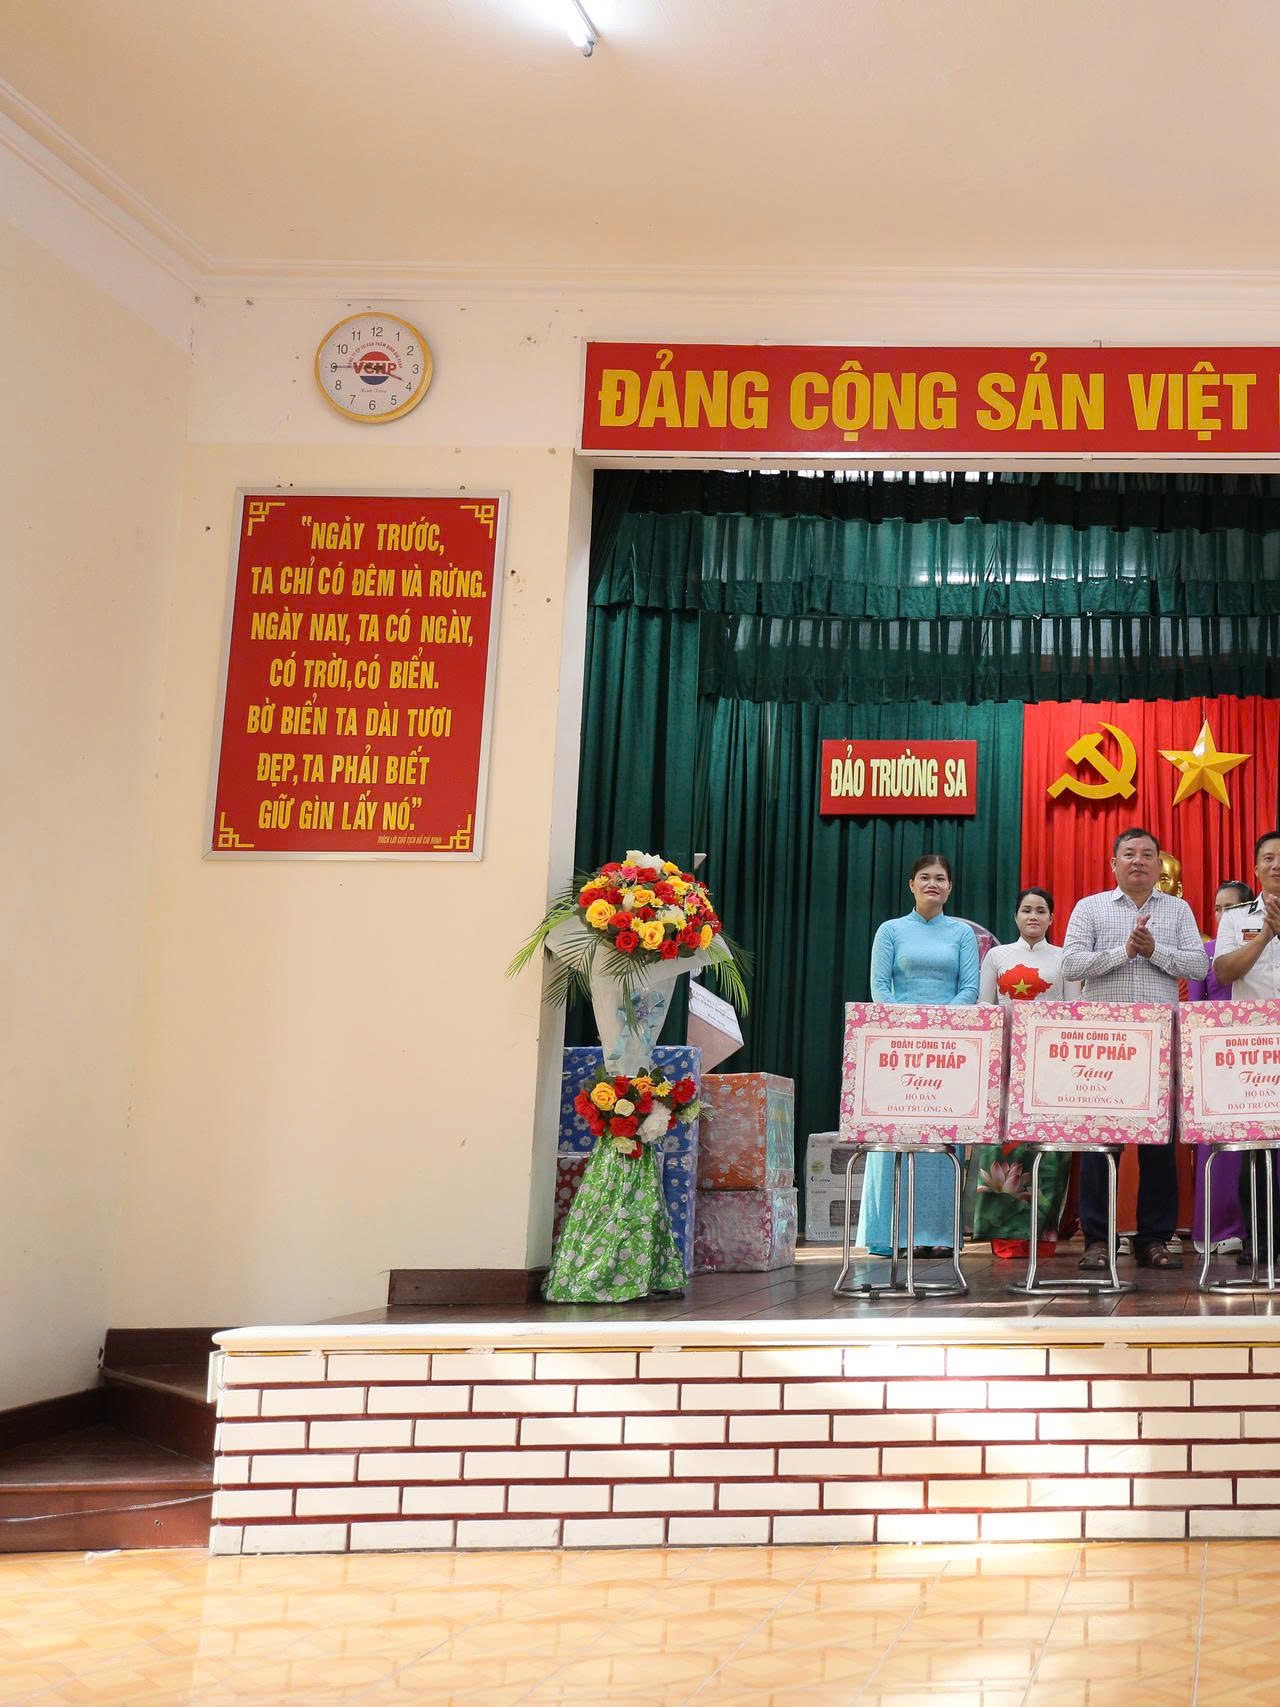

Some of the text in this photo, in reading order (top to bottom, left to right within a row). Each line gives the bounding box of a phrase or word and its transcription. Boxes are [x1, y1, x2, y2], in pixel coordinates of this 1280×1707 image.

[352, 331, 361, 340] 11
[372, 326, 383, 337] 12
[396, 332, 400, 341] 1
[336, 344, 348, 354] 10
[407, 345, 414, 356] 2
[330, 362, 337, 373] 9
[412, 364, 419, 374] 3
[335, 380, 342, 390] 8
[406, 382, 412, 391] 4
[350, 395, 356, 405] 7
[391, 395, 397, 405] 5
[598, 349, 768, 429] ĐẢNG
[790, 361, 956, 441] CỘNG
[977, 352, 1104, 430] SẢN
[1128, 362, 1256, 440] VIỆT
[369, 400, 376, 410] 6
[377, 517, 444, 555] TRƯỚC,
[252, 556, 486, 598] TA CHỈ CÓ ĐÊM VÀ RỪNG.
[251, 607, 473, 646] NGÀY NAY, TA CÓ NGÀY,
[270, 651, 296, 687] CÓ
[355, 654, 380, 689] CÓ
[390, 647, 438, 688] BIỂN.
[247, 693, 451, 737] BỜ BIỂN TA DÀI TƯƠI
[303, 754, 324, 782] TA
[331, 744, 378, 783] PHẢI
[386, 746, 430, 784] BIẾT
[831, 745, 967, 797] ĐẢO TRƯỜNG SA
[259, 794, 295, 829] GIỮ
[299, 795, 334, 829] GÌN
[342, 790, 378, 830] LẤY
[1061, 1030, 1127, 1041] ĐOÀN CÔNG TÁC
[1225, 1037, 1248, 1047] ĐOÀN
[1251, 1036, 1274, 1046] CÔNG
[890, 1039, 957, 1050] ĐOÀN CÔNG TÁC
[1049, 1041, 1137, 1062] BỘ TƯ PHÁP
[879, 1050, 967, 1070] BỘ TƯ PHÁP
[1215, 1049, 1235, 1069] BỘ
[1240, 1049, 1259, 1065] TƯ
[1071, 1065, 1114, 1081] Tặng
[1239, 1071, 1280, 1087] Tặng
[900, 1073, 943, 1090] Tặng
